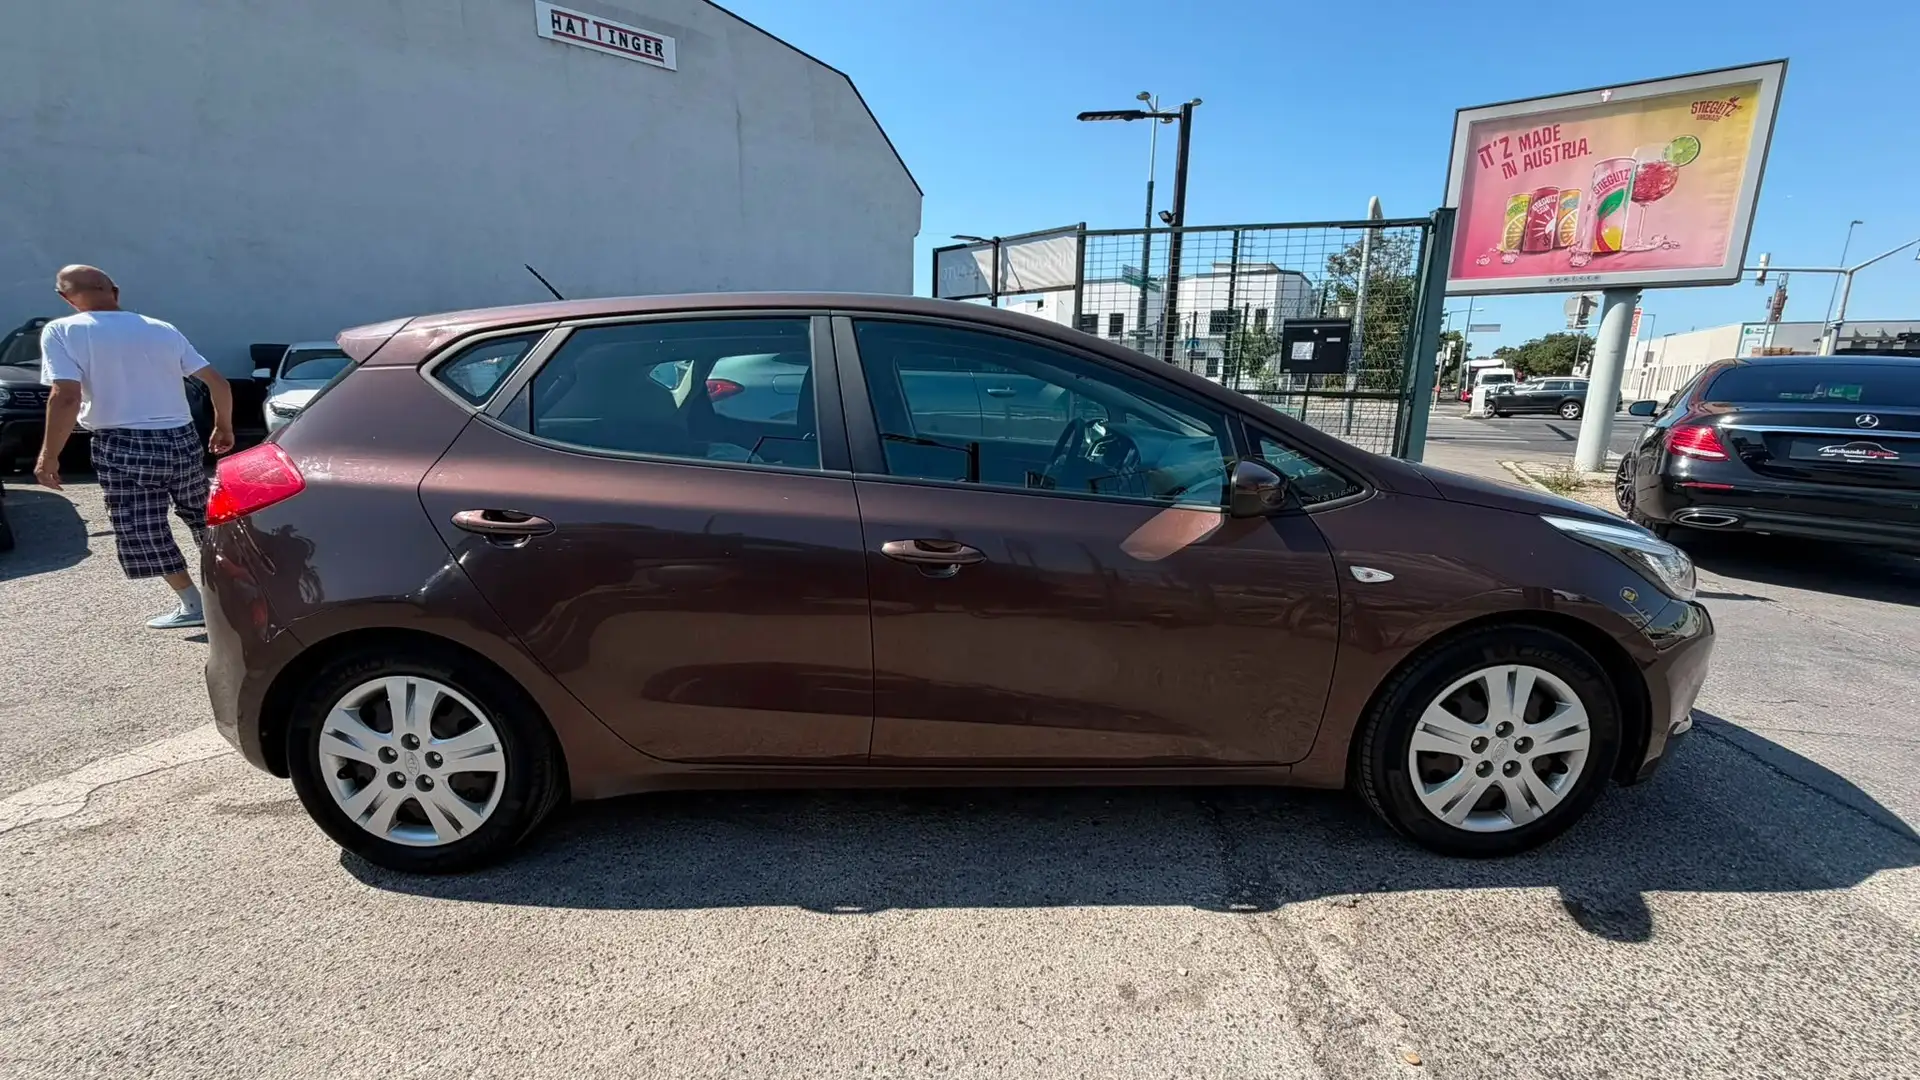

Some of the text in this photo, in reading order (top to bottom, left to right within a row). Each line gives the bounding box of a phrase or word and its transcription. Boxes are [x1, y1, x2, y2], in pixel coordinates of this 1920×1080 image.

[551, 11, 664, 58] HATTINGER
[1518, 124, 1561, 152] MADE
[1501, 138, 1592, 180] IN AUSTRIA.
[1593, 168, 1632, 195] STIEGLITZ
[1824, 447, 1866, 455] Autohandel
